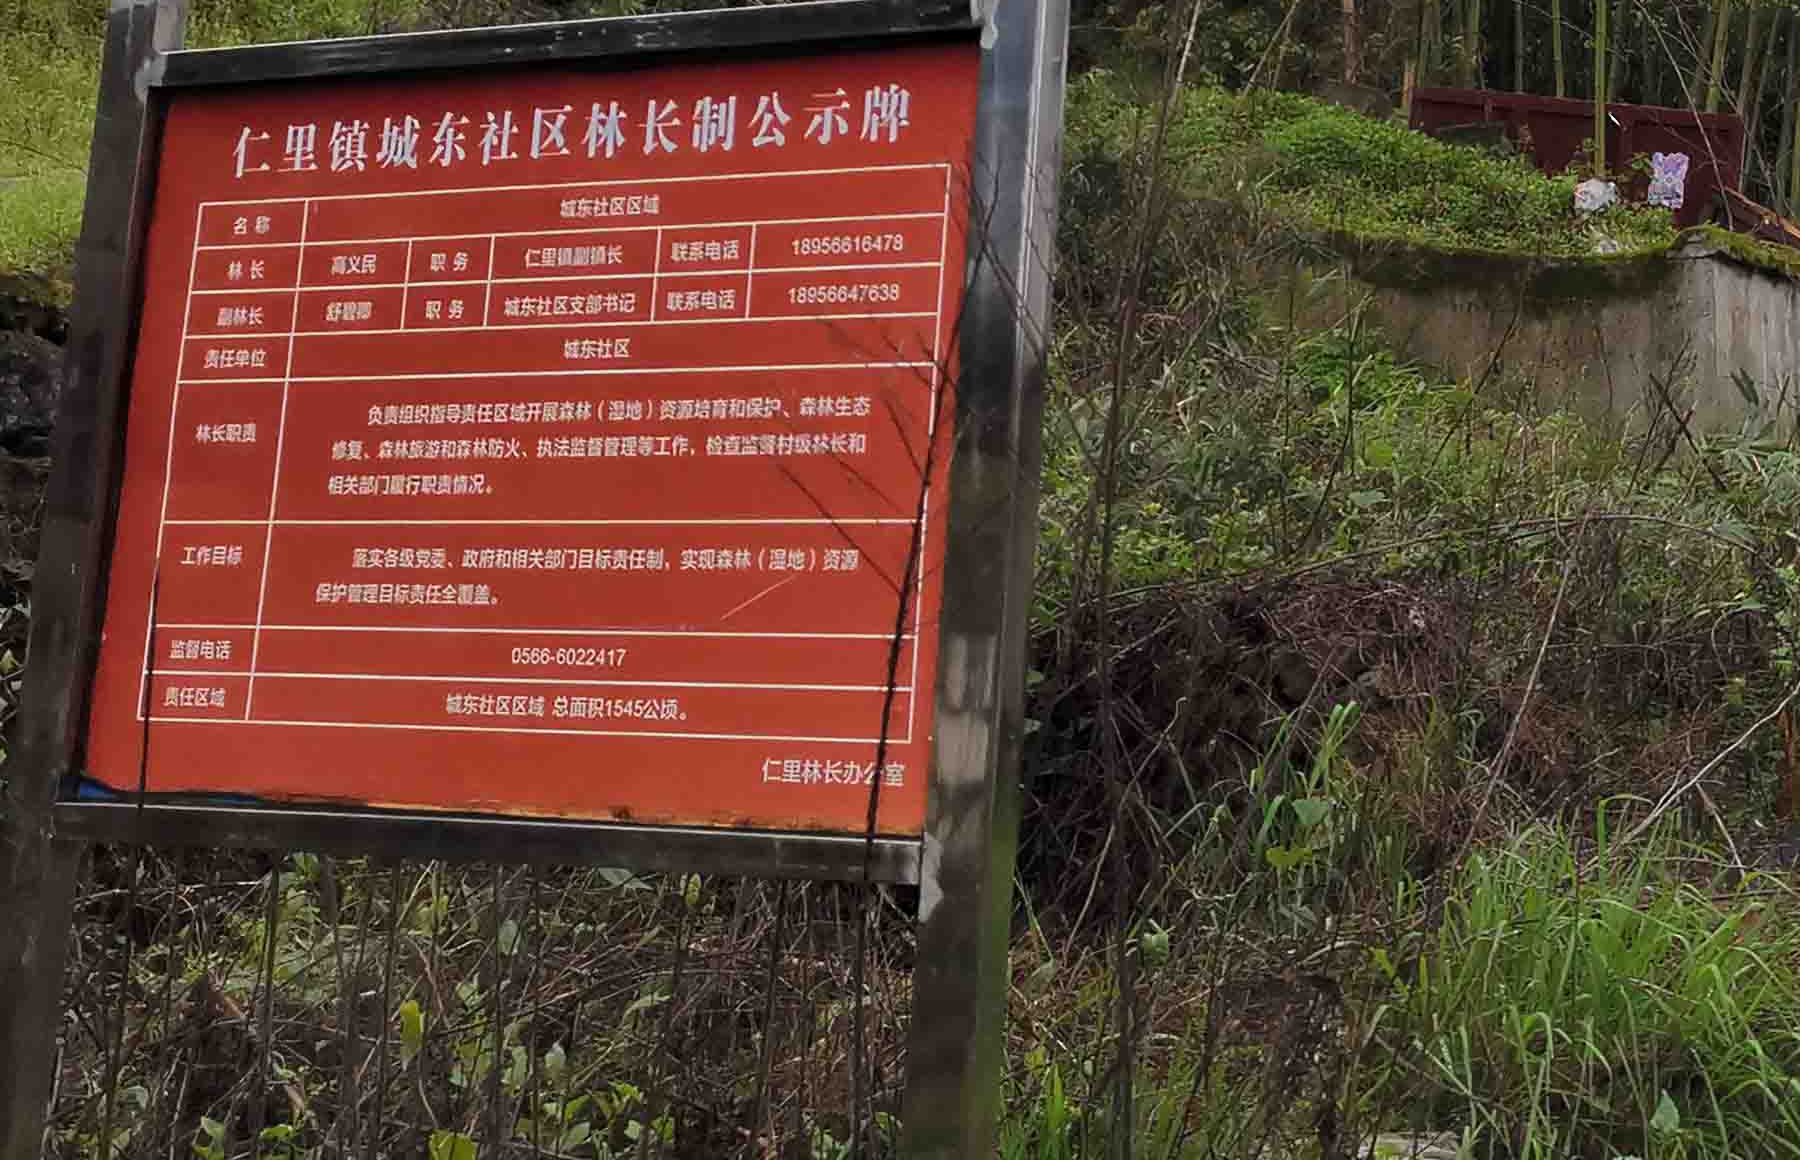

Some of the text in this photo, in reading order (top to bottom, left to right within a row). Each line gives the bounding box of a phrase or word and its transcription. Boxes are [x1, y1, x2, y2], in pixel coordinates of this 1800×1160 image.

[233, 83, 910, 178] 仁里镇城东社区林长制公示牌
[560, 193, 659, 218] 城东社区区域
[671, 240, 739, 262] 联系电话
[791, 233, 904, 256] 18956616478
[524, 244, 623, 269] 仁里镇副镇长
[504, 292, 636, 318] 城东社区支部书记
[666, 289, 736, 312] 联系电话
[787, 283, 900, 305] 18956647638
[217, 306, 264, 327] 副林长
[203, 348, 266, 369] 责任单位
[564, 337, 631, 359] 城东社区
[196, 423, 257, 443] 林长职责
[181, 545, 243, 567] 工作目标
[169, 639, 232, 661] 监督电话
[510, 646, 627, 667] 0566-6022417
[163, 687, 226, 708] 责任区域
